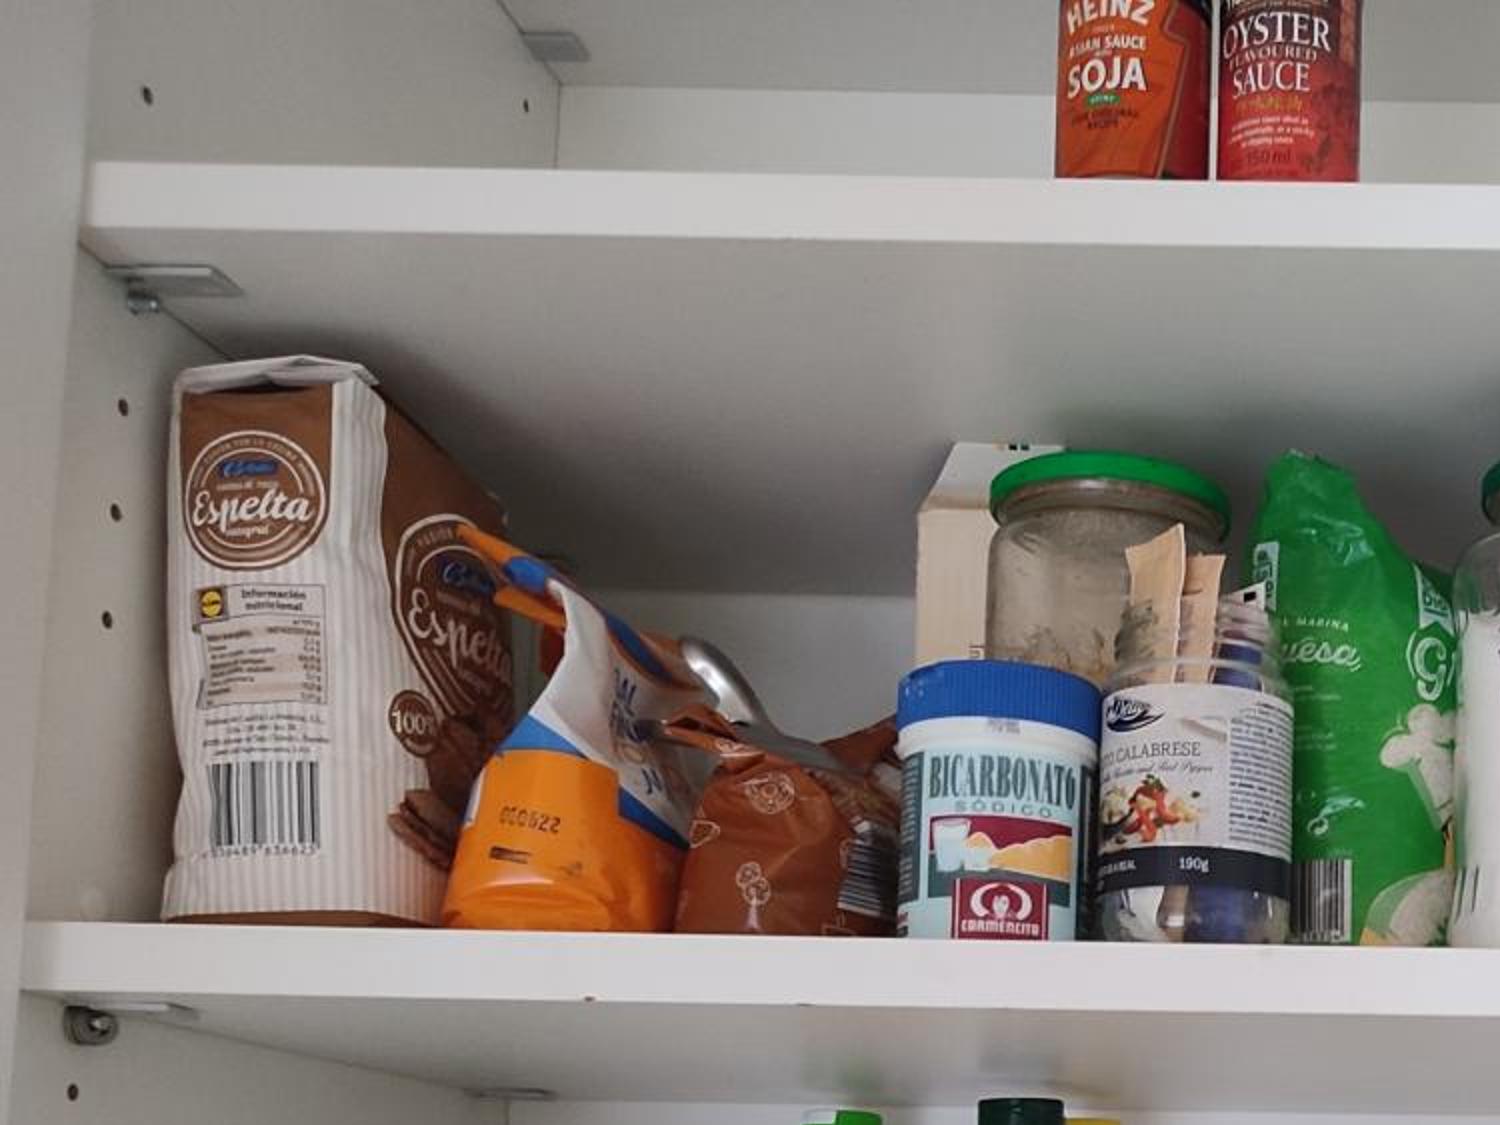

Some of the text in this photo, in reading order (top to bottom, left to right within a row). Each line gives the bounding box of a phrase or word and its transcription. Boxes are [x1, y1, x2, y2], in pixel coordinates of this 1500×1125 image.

[1067, 0, 1155, 35] HEINZ
[1223, 11, 1332, 58] OYSTER
[1105, 35, 1147, 50] SAUCE
[1067, 56, 1148, 99] SOJA
[1233, 61, 1311, 99] SAUCE
[193, 487, 316, 533] Espelta
[1116, 741, 1202, 763] CALABRESE
[929, 754, 1077, 810] BICARBONATO
[1179, 857, 1210, 874] 190g
